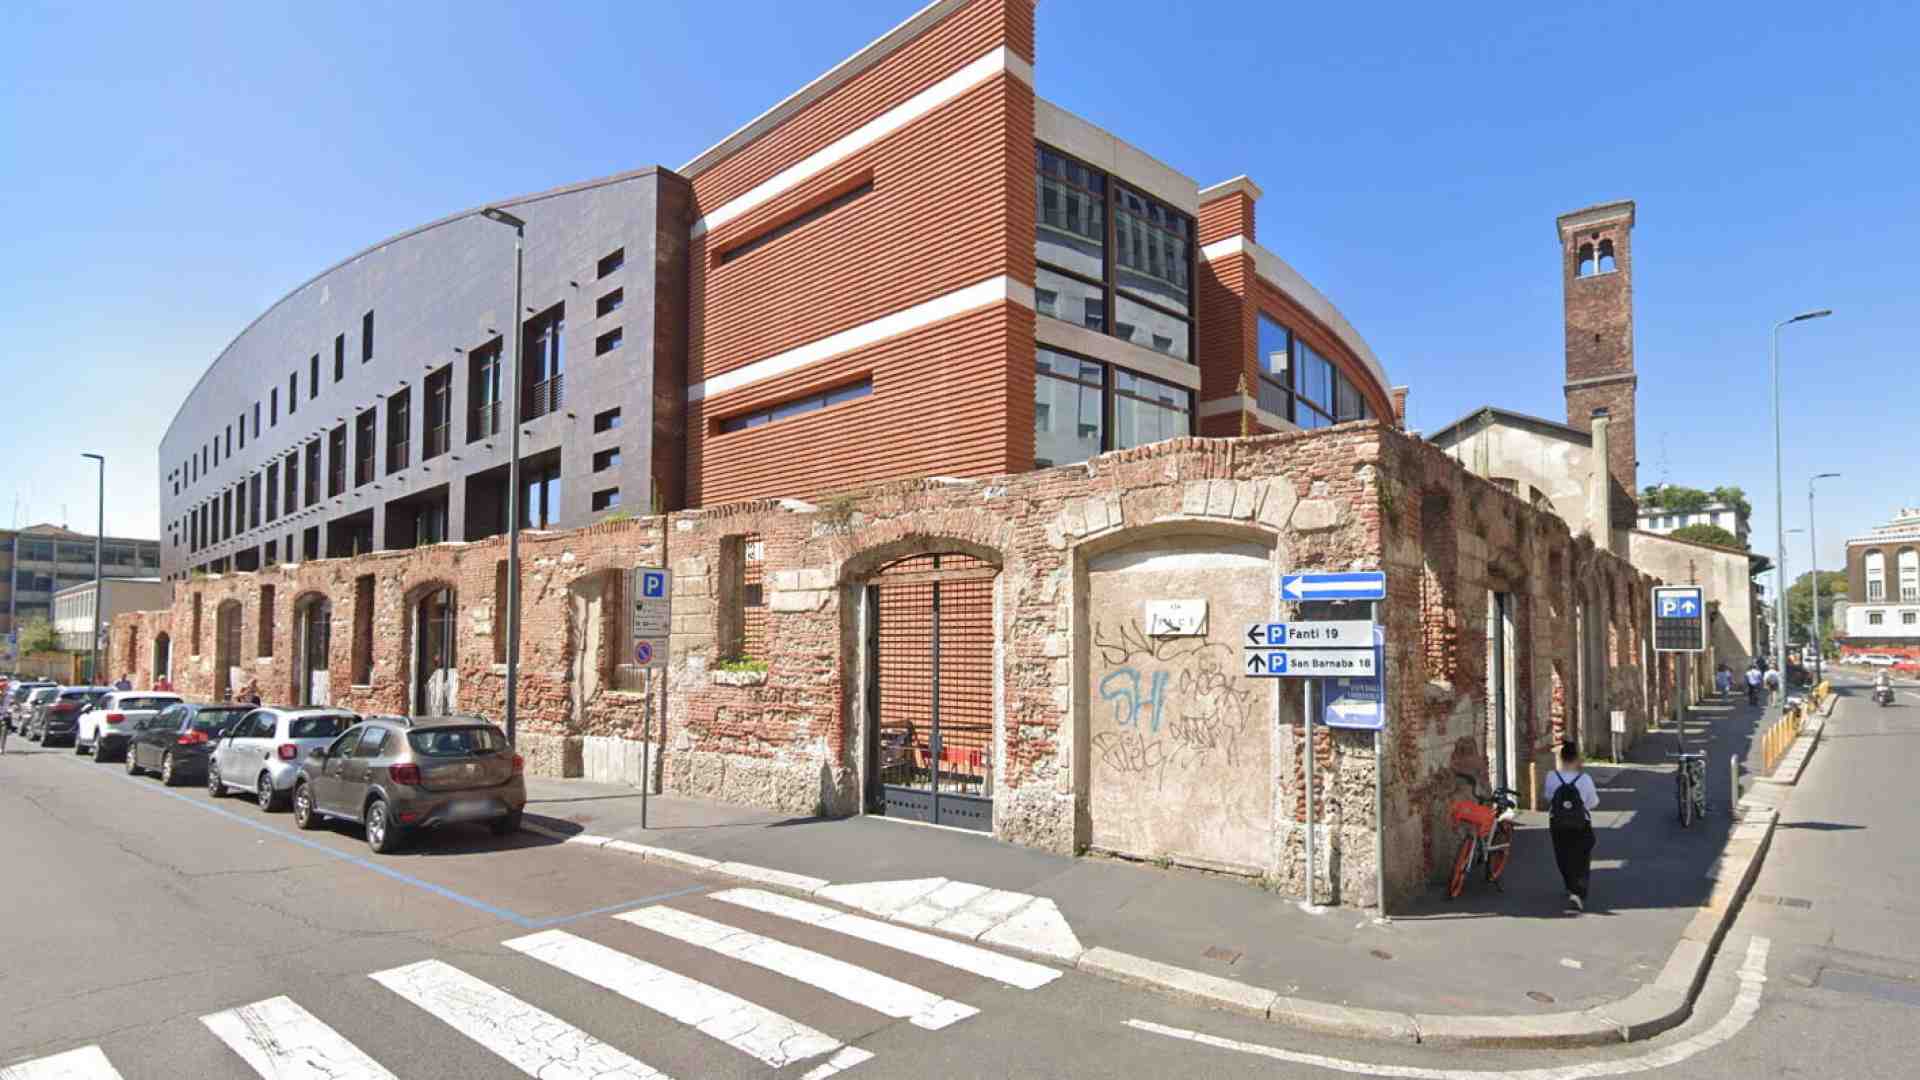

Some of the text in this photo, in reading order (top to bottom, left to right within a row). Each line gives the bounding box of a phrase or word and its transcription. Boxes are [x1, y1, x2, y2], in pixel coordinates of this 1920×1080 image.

[647, 576, 660, 596] P
[1662, 599, 1677, 617] P
[1270, 625, 1339, 643] P Fanti 19
[1271, 655, 1285, 672] P
[1290, 658, 1310, 668] San
[1312, 658, 1355, 668] Barnaba
